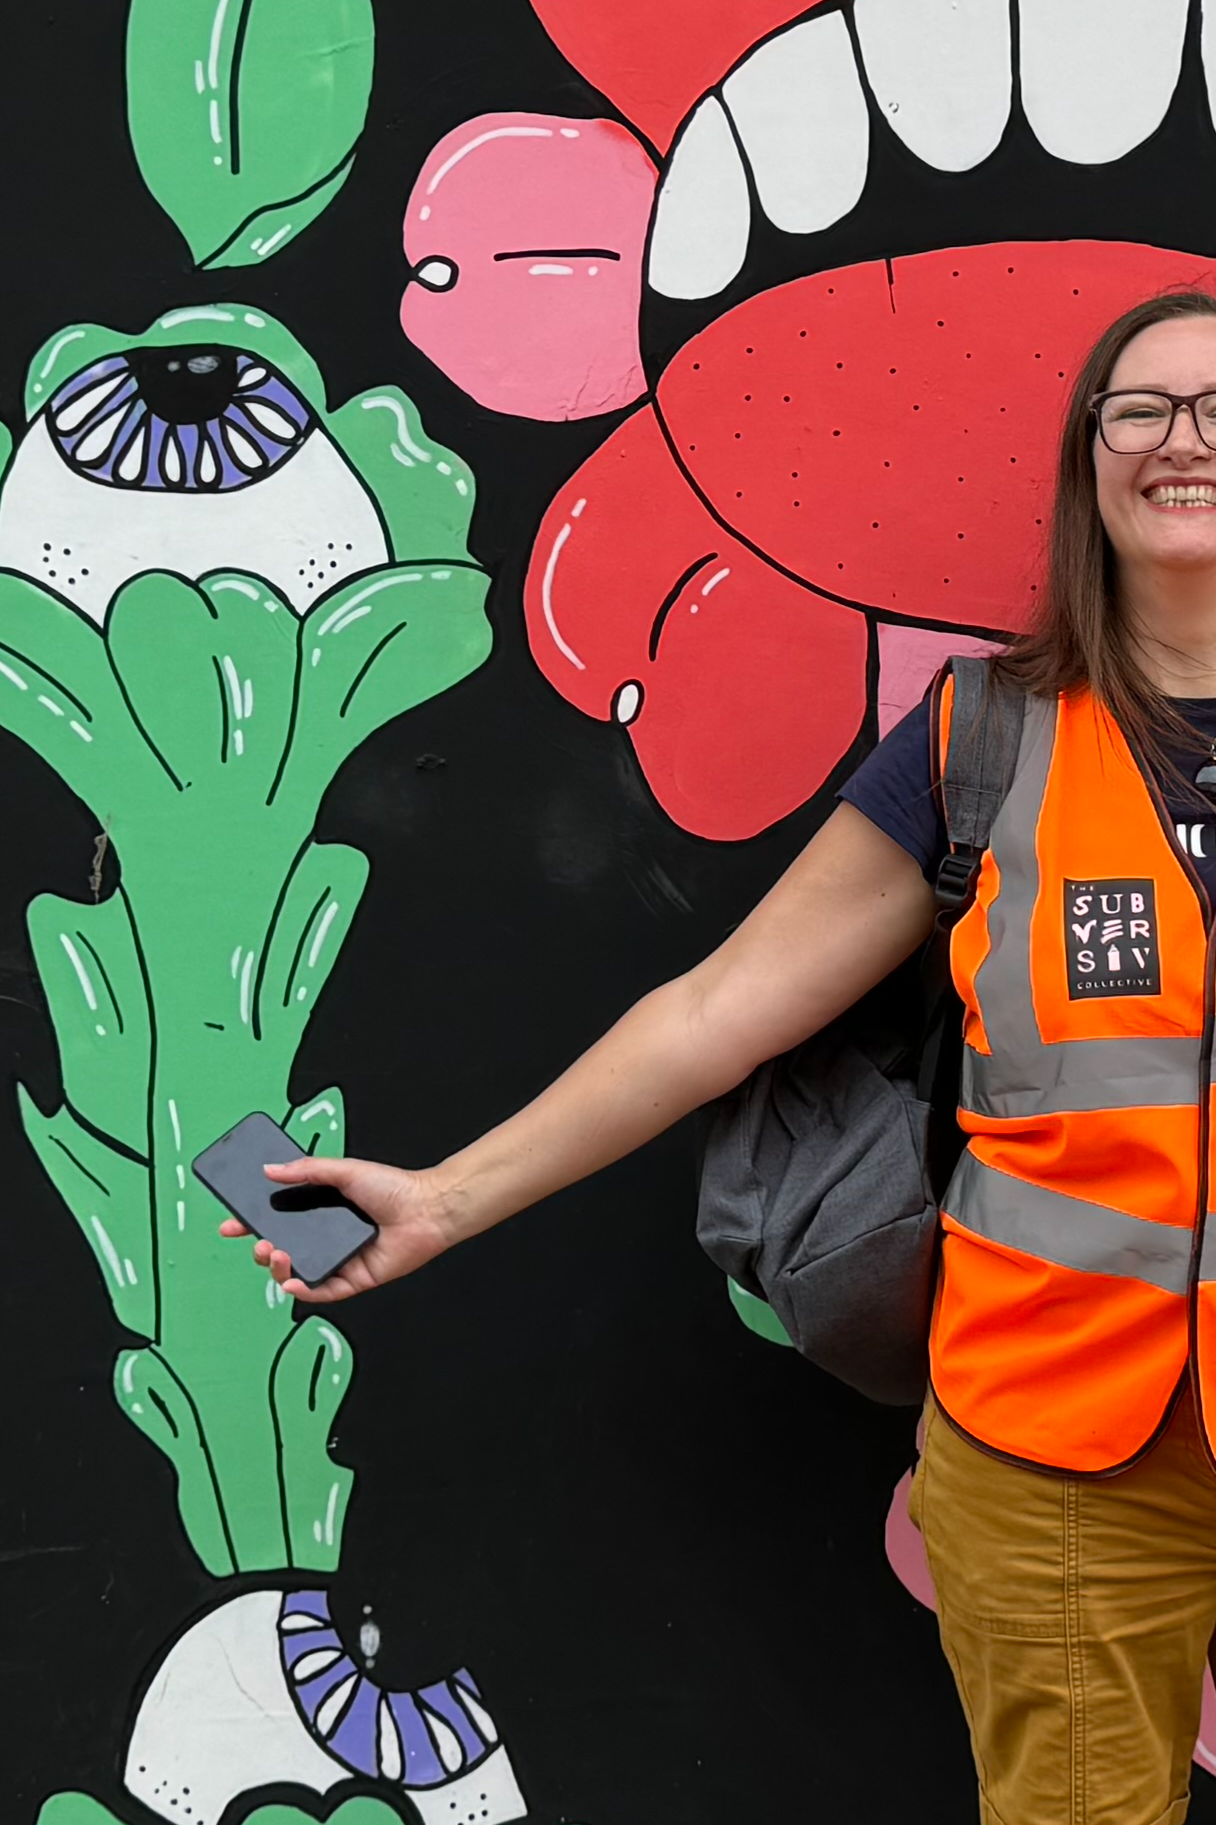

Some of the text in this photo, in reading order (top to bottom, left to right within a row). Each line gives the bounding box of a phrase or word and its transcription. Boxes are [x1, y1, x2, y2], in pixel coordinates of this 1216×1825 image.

[1072, 893, 1145, 916] SUB
[1071, 919, 1150, 944] VER
[1077, 979, 1151, 990] COLLECTIVE
